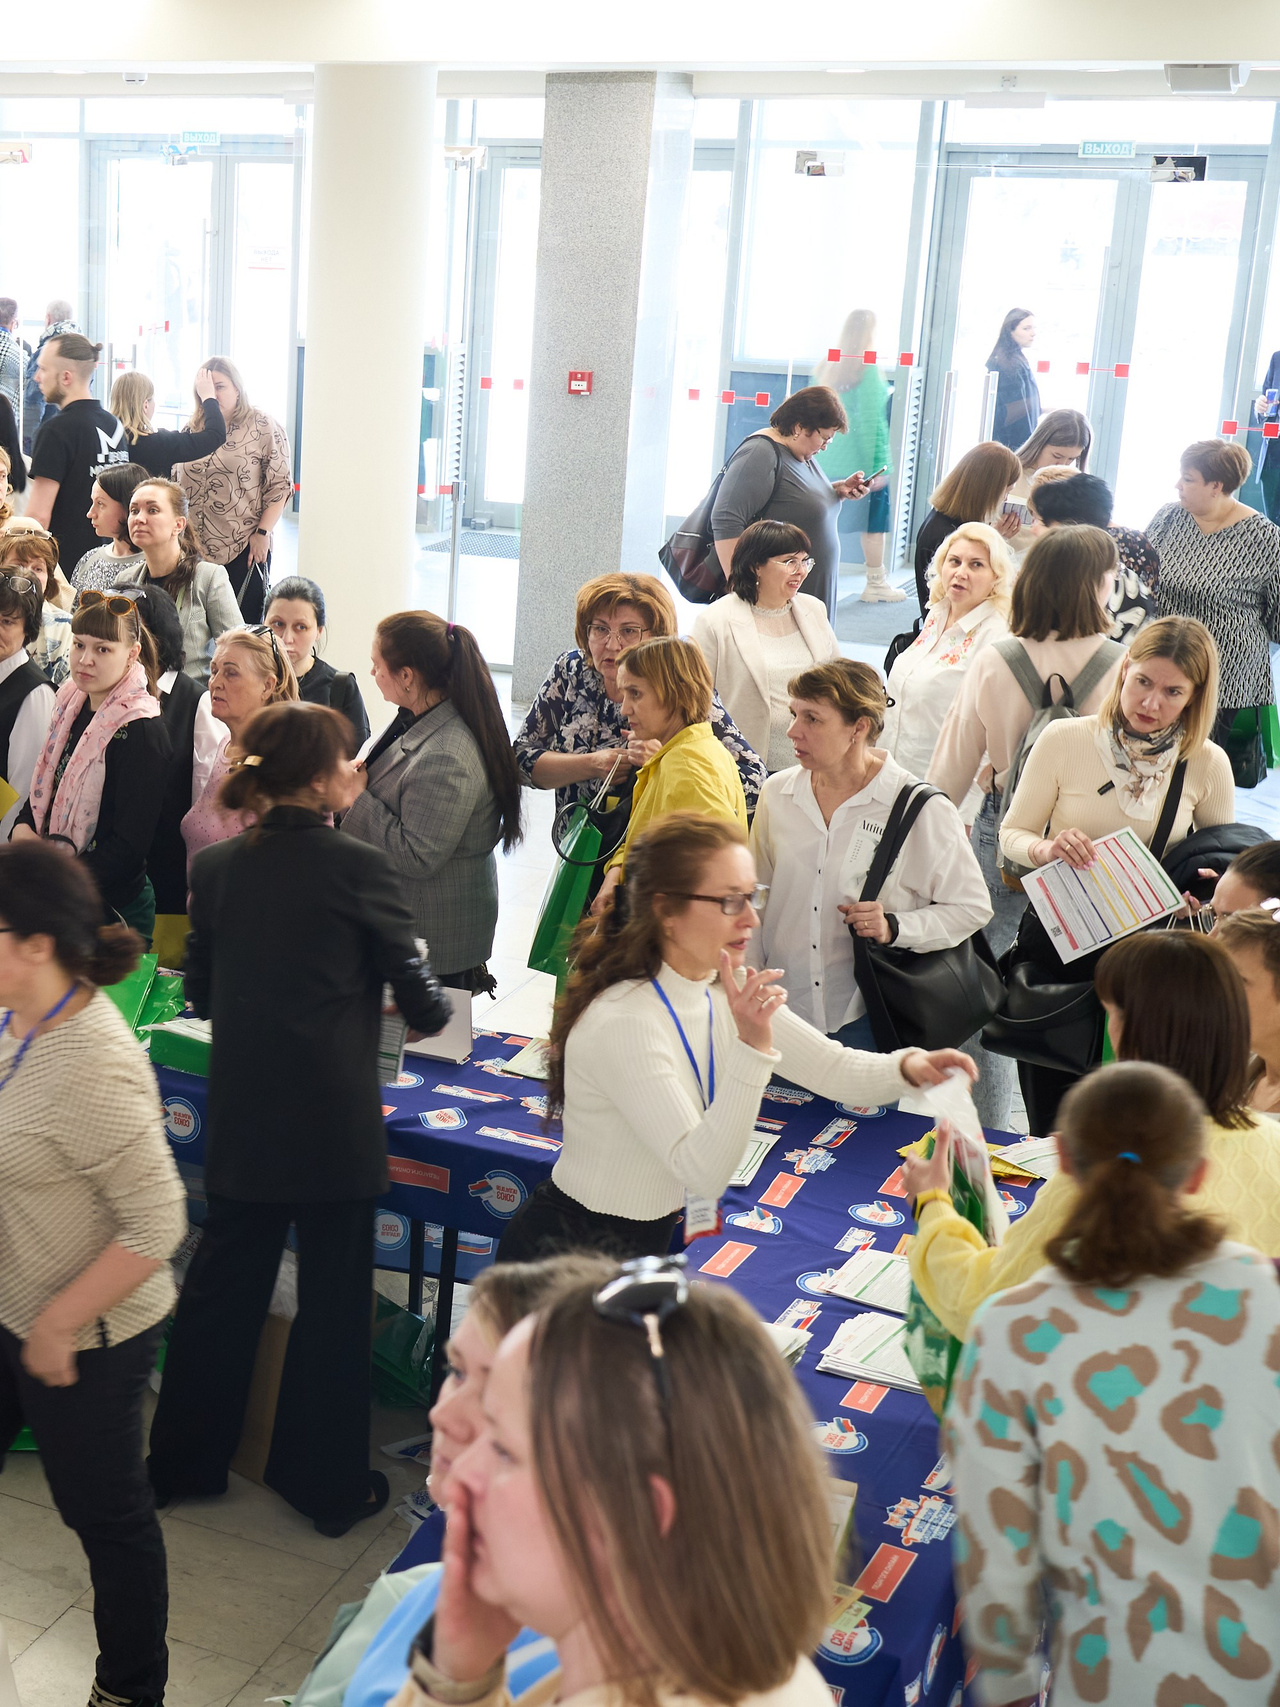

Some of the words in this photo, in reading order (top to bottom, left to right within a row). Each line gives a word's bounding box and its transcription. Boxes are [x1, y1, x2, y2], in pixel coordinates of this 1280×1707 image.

[184, 133, 215, 143] ВЫХОД
[1085, 143, 1130, 155] ВЫХОД
[496, 1191, 515, 1203] СОЮЗ
[830, 1630, 847, 1647] СОЮ
